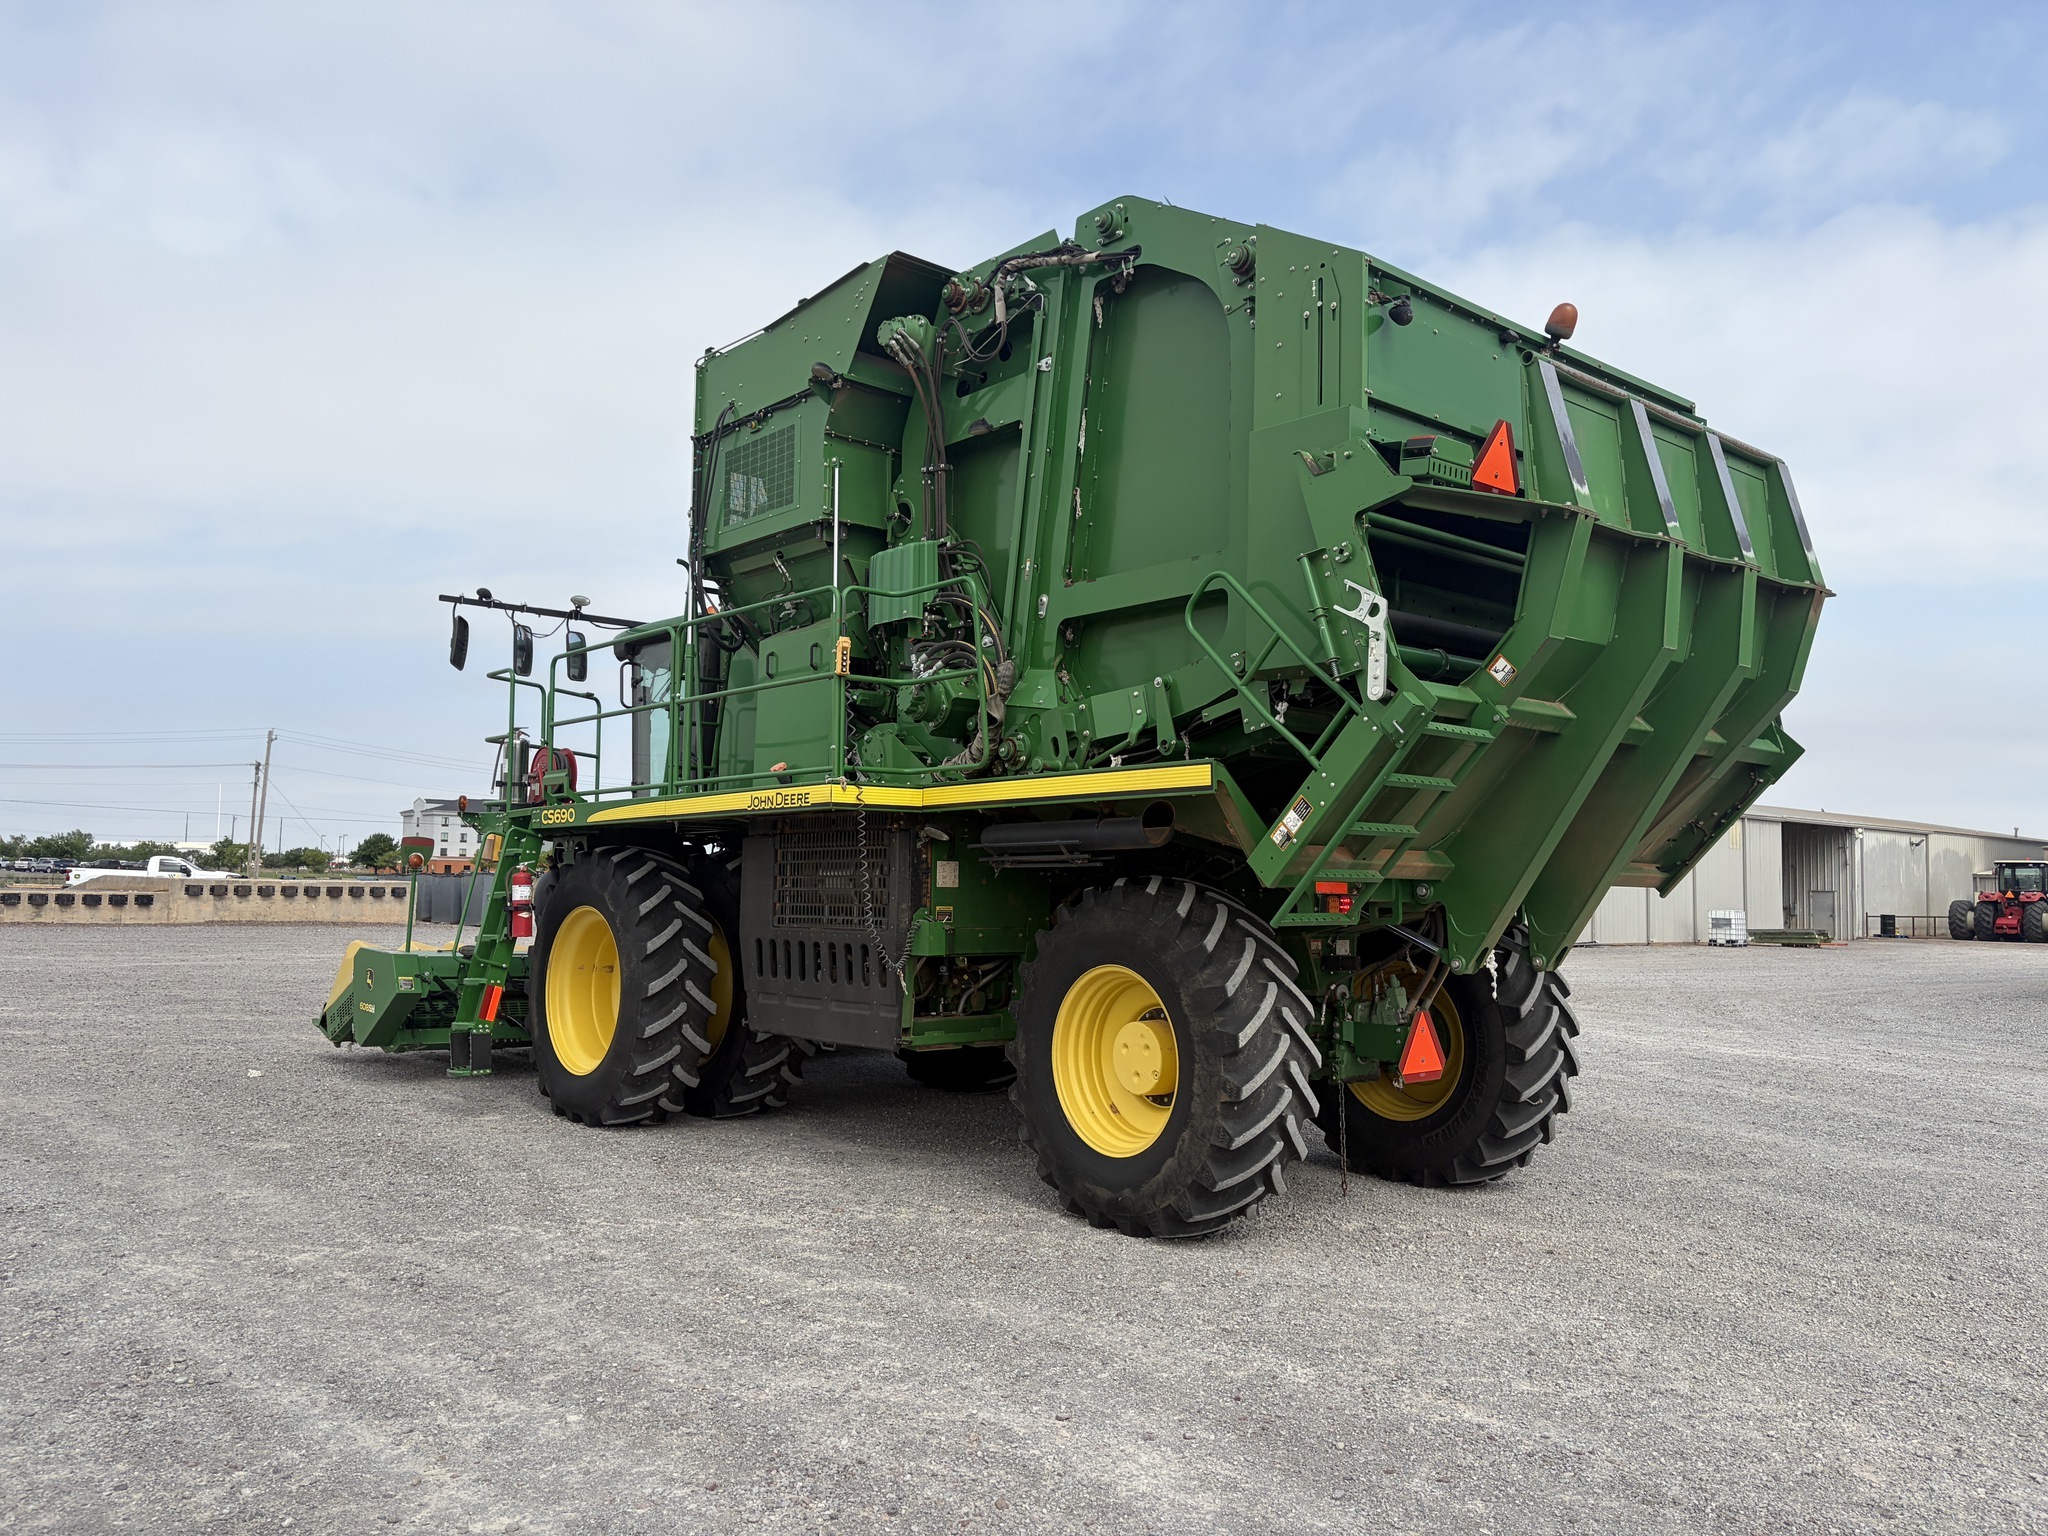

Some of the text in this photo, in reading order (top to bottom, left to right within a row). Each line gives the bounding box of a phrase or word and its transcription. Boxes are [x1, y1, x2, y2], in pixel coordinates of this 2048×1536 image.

[747, 792, 811, 808] JOHN DEERE
[541, 807, 576, 825] CS690
